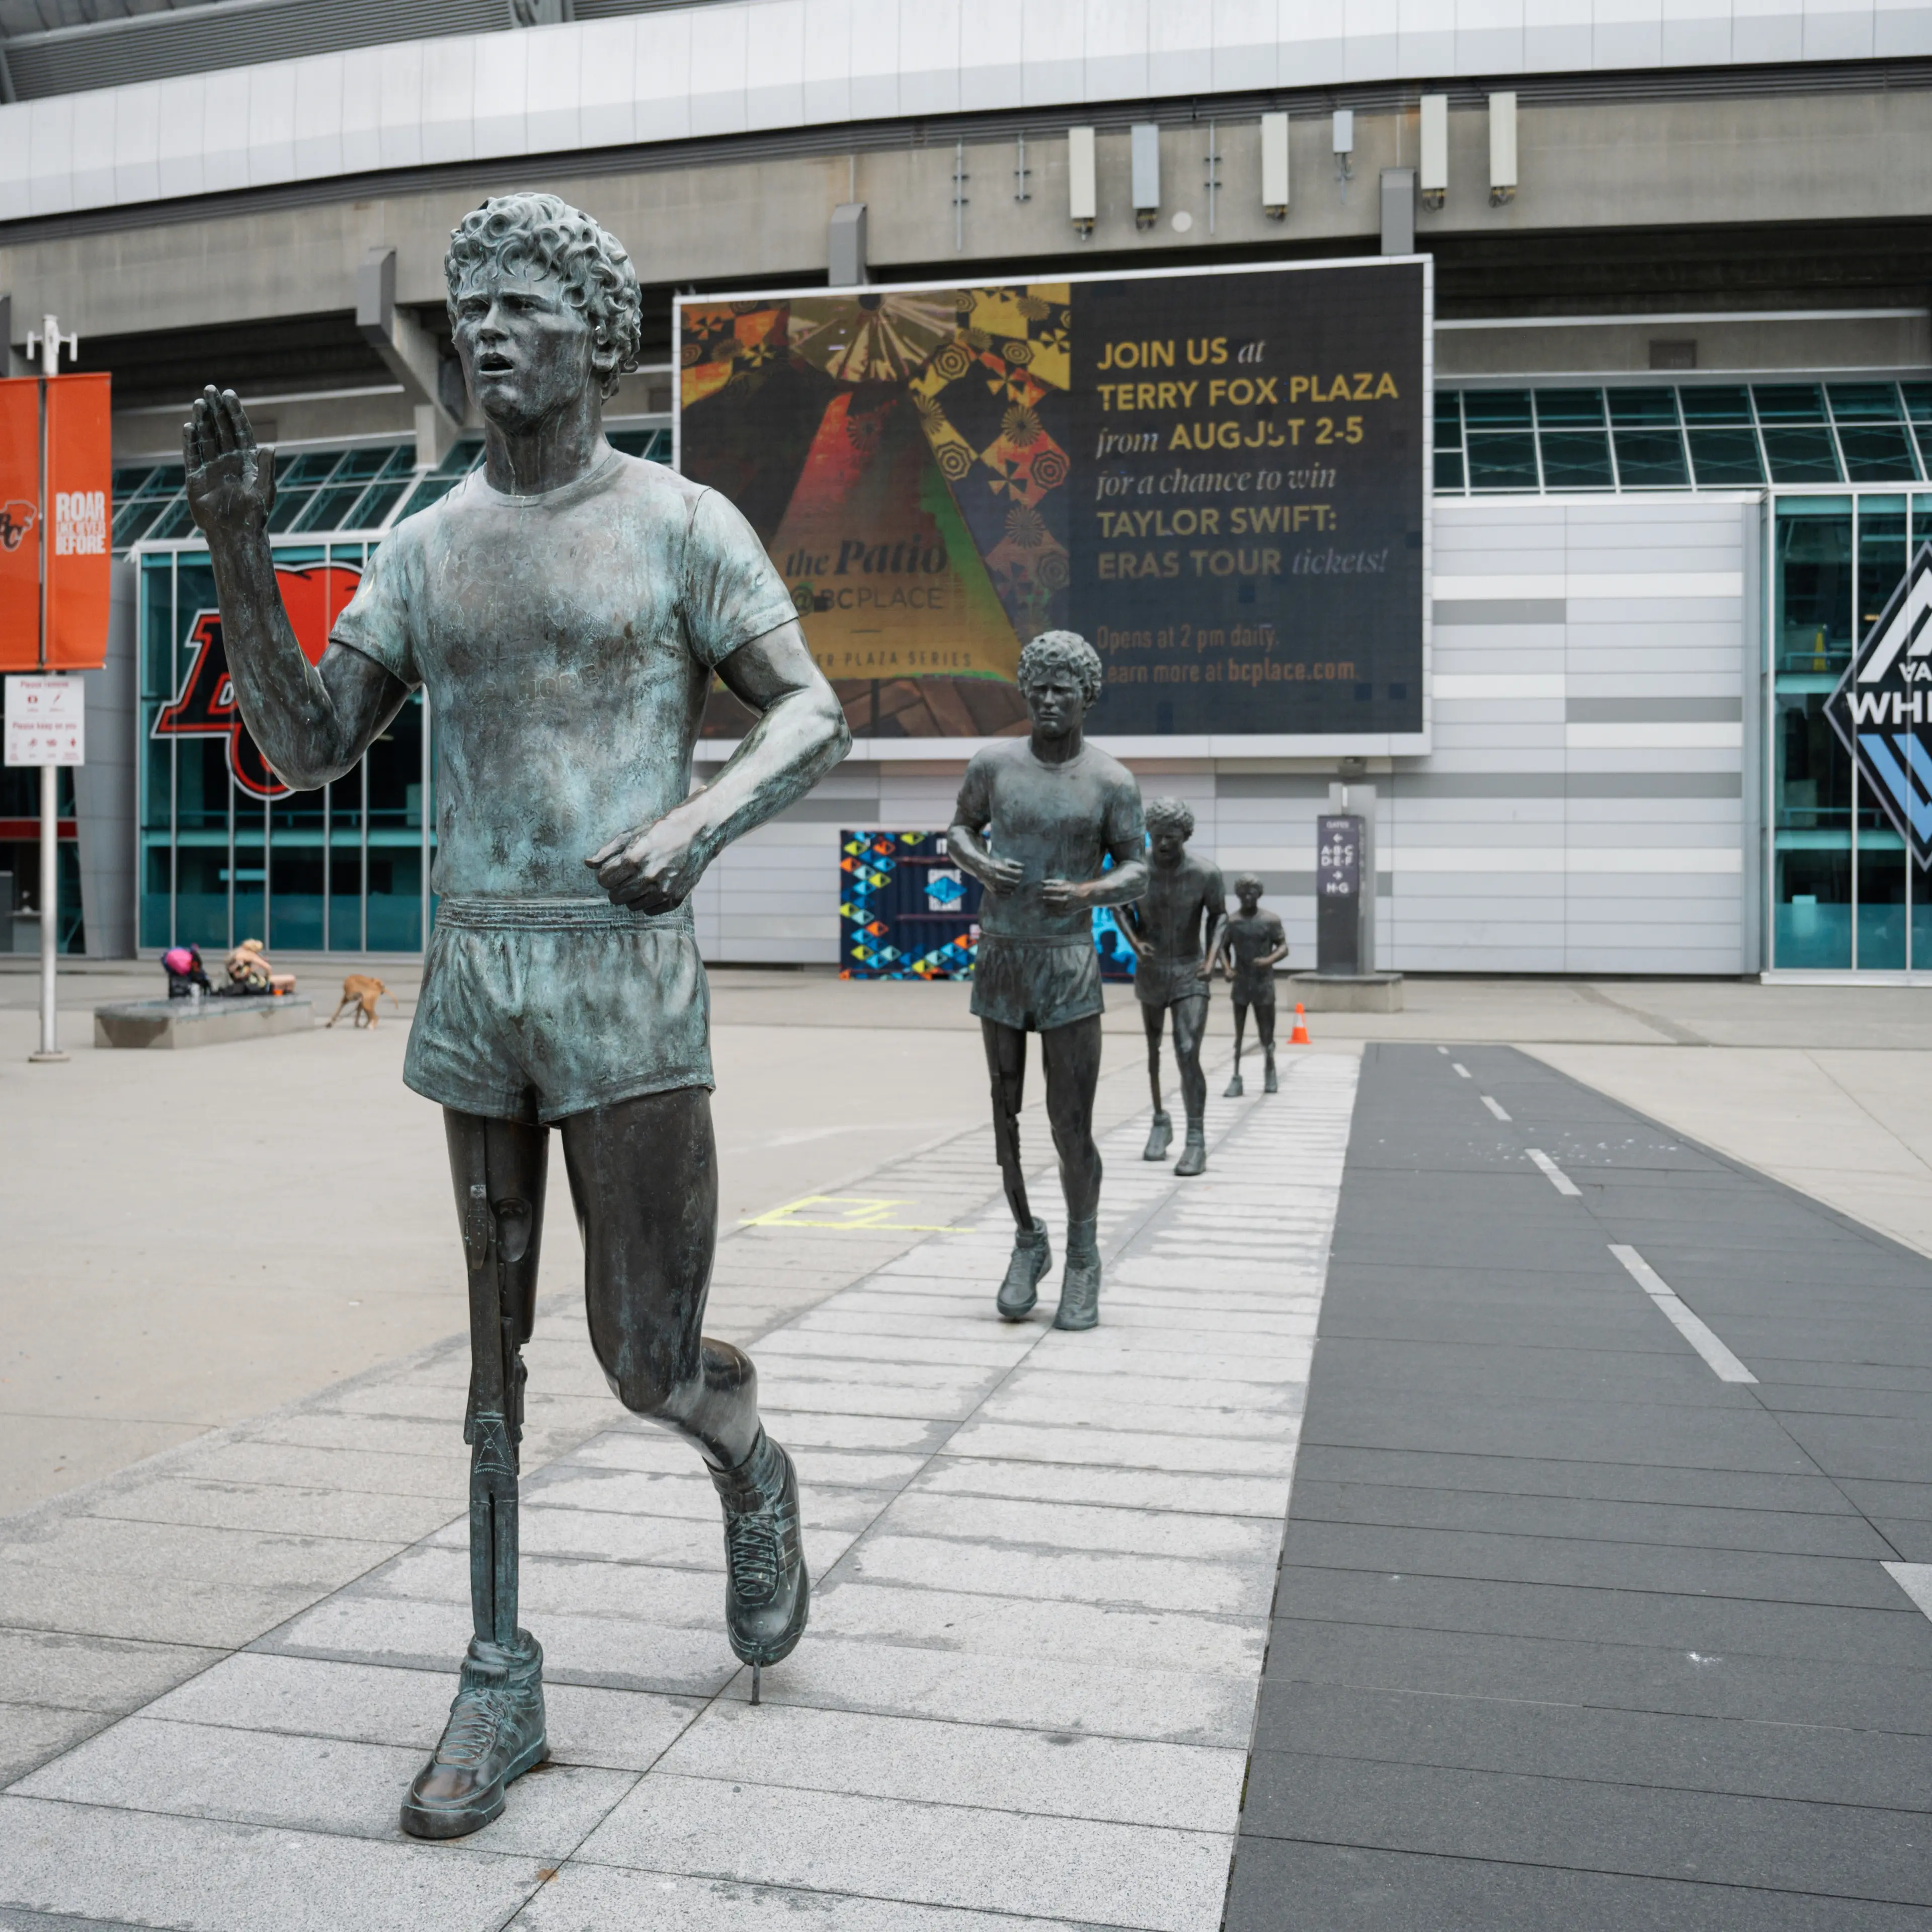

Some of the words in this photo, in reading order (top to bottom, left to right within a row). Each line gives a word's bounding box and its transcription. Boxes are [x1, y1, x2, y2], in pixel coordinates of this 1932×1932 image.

[1097, 340, 1175, 370] JOIN
[1186, 337, 1228, 365] US
[1237, 340, 1266, 364] at
[1097, 380, 1199, 411] TERRY
[1209, 377, 1278, 407] FOX
[1290, 372, 1399, 403] PLAZA
[1096, 427, 1159, 459] from
[1315, 417, 1363, 445] 2-5
[1096, 470, 1134, 501] for
[1138, 472, 1153, 495] a
[1159, 467, 1251, 494] chance
[1256, 467, 1281, 492] to
[1287, 461, 1336, 489] win
[55, 491, 105, 521] ROAR
[1096, 509, 1220, 538] TAYLOR
[55, 534, 106, 555] BEFORE
[785, 549, 829, 577] the
[834, 533, 948, 575] Patio
[1098, 552, 1179, 579] ERAS
[1189, 549, 1281, 577] TOUR
[1292, 548, 1389, 574] tickets!
[1097, 626, 1152, 655] Opens
[1157, 624, 1174, 649] at
[1180, 624, 1191, 648] 2
[1197, 630, 1225, 653] pm
[844, 651, 898, 667] PLAZA
[908, 651, 972, 667] SERIES
[1153, 664, 1198, 683] more
[1204, 661, 1223, 682] at
